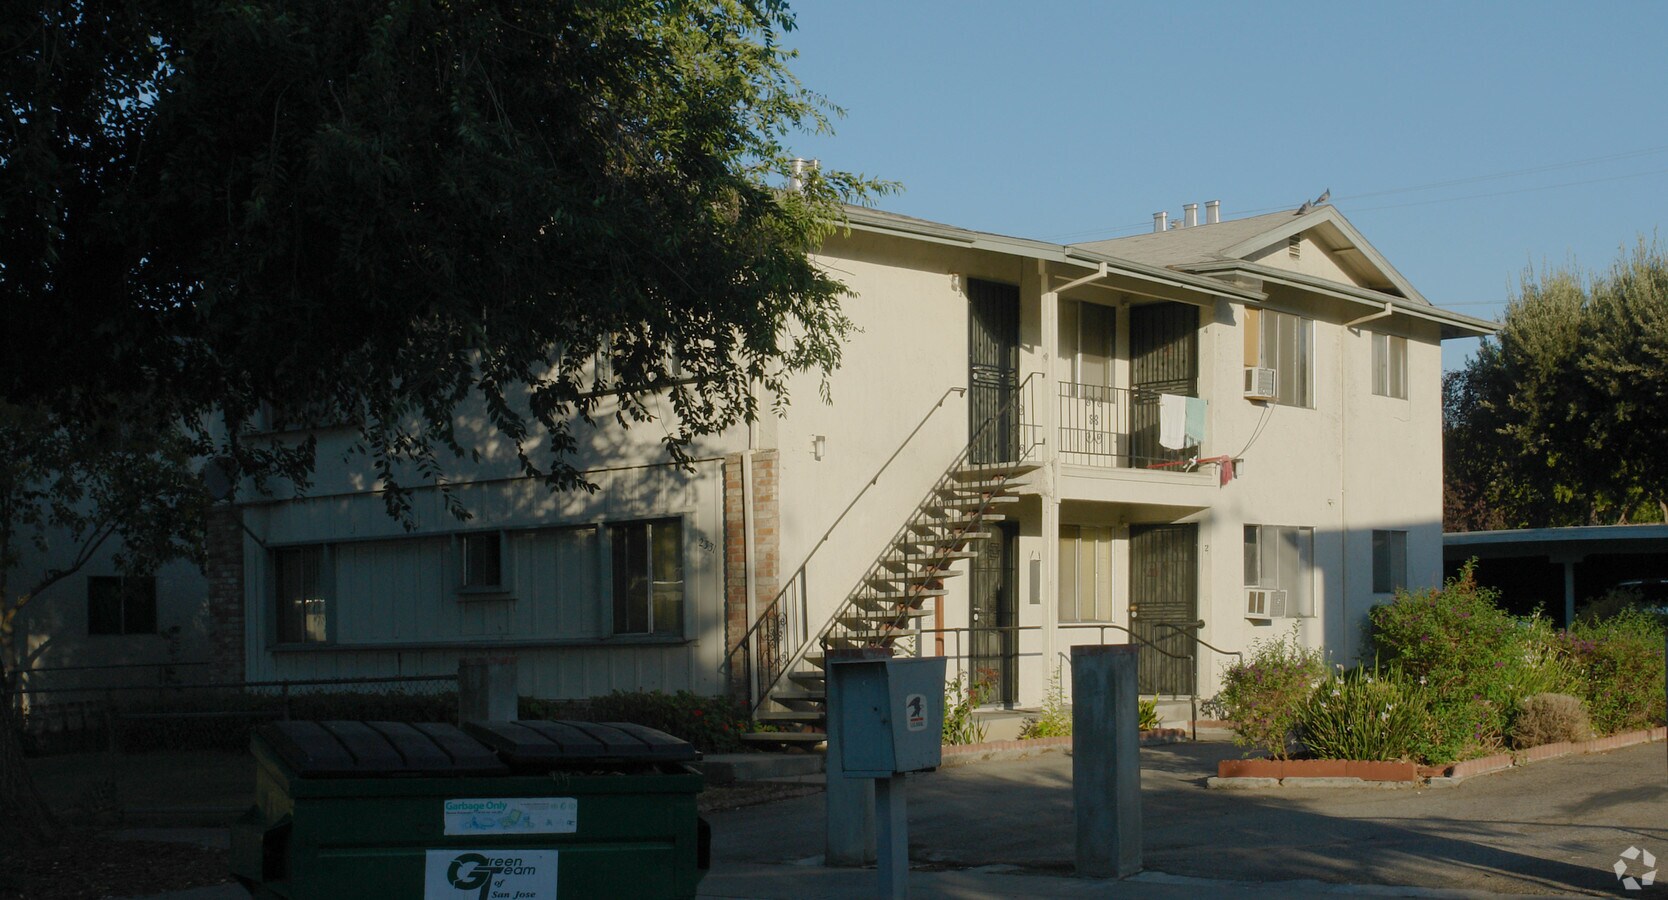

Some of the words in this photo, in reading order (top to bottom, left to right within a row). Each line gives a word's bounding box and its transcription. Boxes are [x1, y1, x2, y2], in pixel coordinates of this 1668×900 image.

[446, 801, 484, 812] Garbage
[486, 800, 508, 811] Only
[447, 853, 523, 890] Green
[494, 879, 505, 888] of
[491, 890, 510, 899] San
[512, 890, 536, 900] Jose
